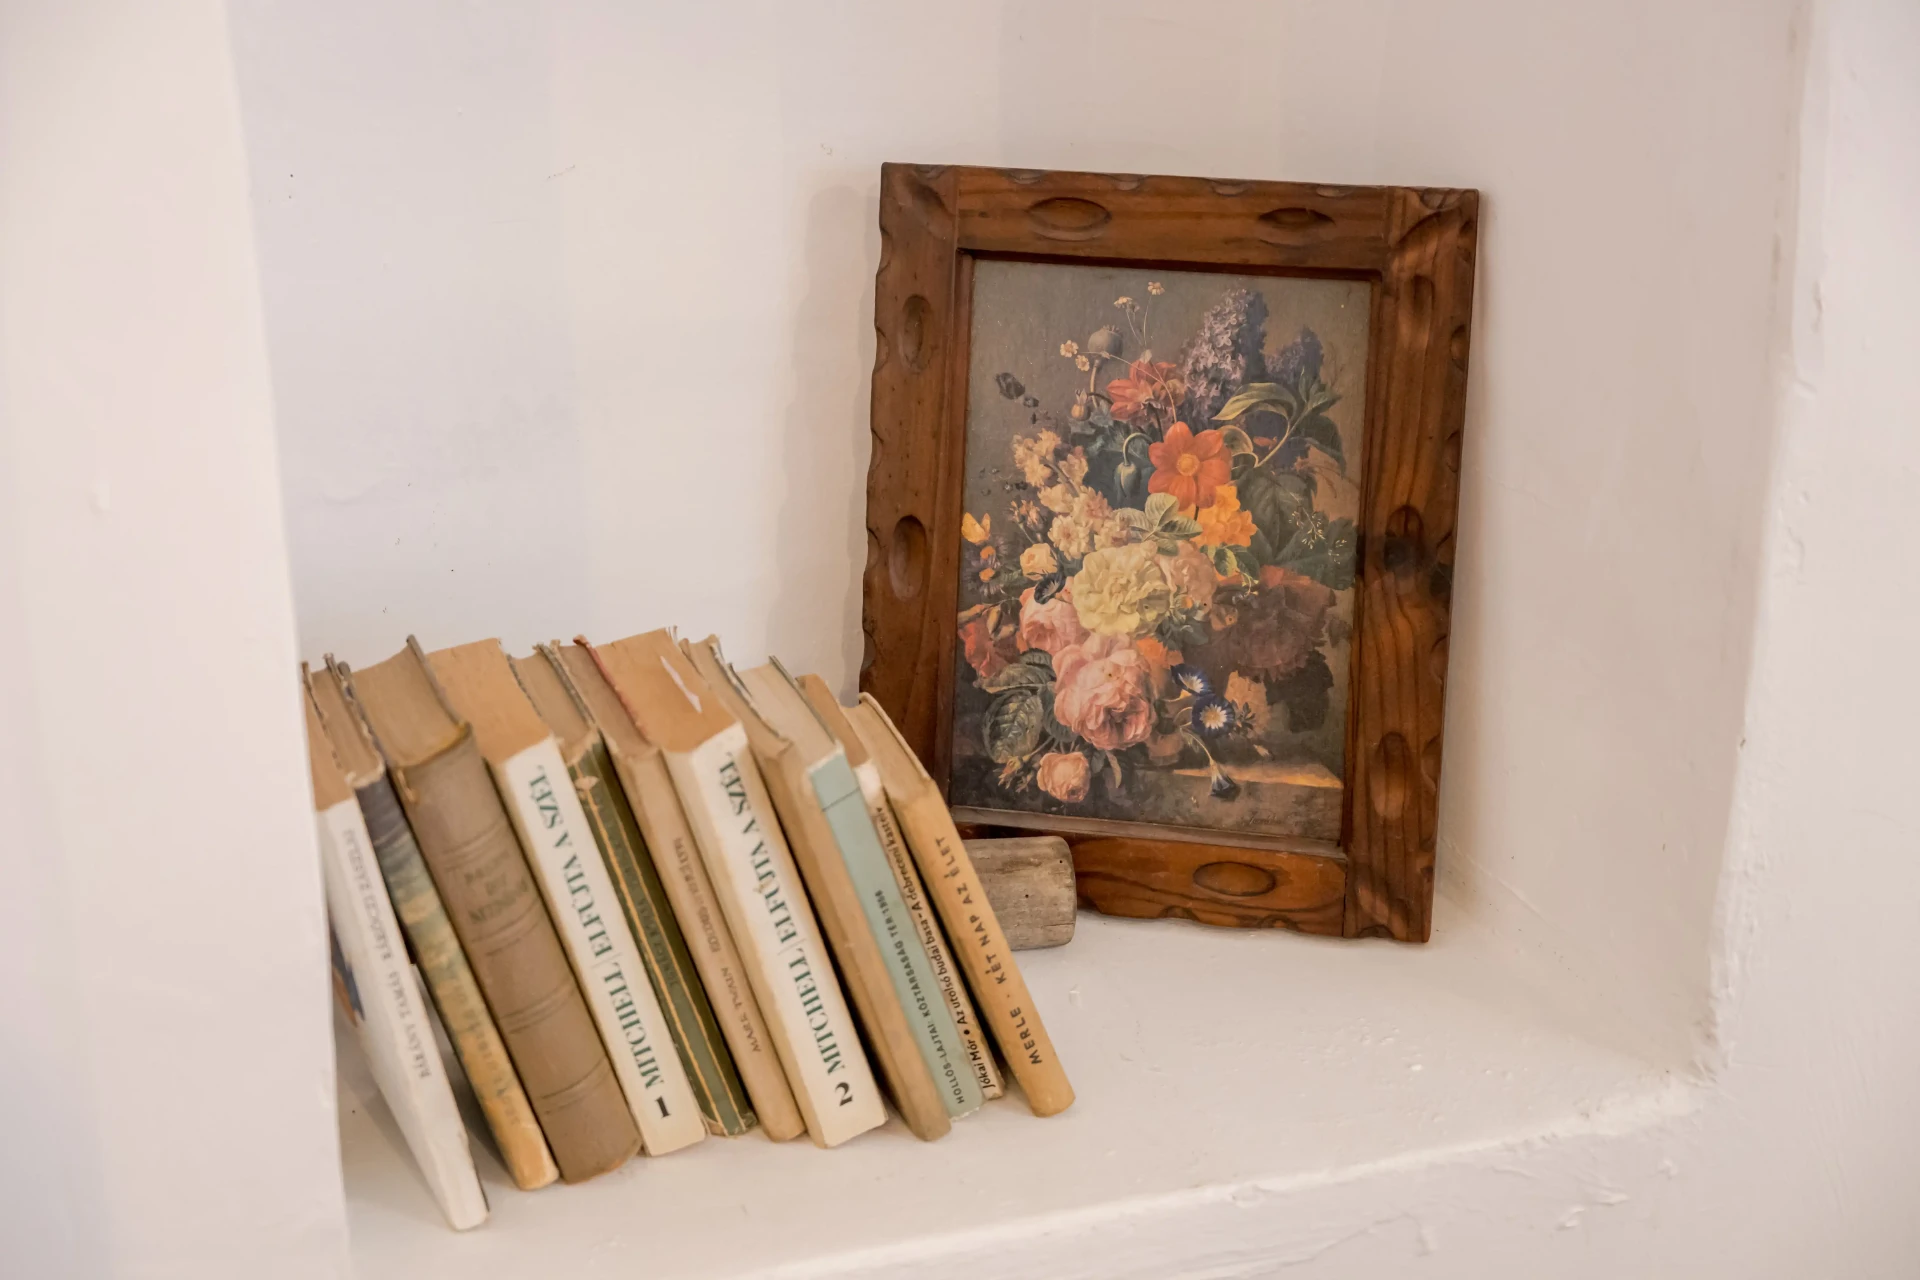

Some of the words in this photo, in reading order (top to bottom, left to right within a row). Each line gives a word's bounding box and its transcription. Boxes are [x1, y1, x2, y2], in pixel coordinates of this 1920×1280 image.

[528, 763, 566, 829] SZÉL
[719, 752, 754, 815] SZÉL
[550, 828, 573, 851] A
[738, 816, 760, 837] A
[885, 844, 921, 902] debreceni
[933, 834, 962, 880] ÉLET
[560, 854, 616, 957] ELFÚJTA
[747, 840, 800, 944] ELFÚJTA
[954, 881, 974, 907] AZ
[967, 911, 991, 947] NAP
[925, 942, 949, 976] budai
[984, 951, 1008, 985] KÉT
[786, 946, 847, 1073] MITCHELL
[938, 974, 963, 1010] utolsó
[603, 961, 666, 1088] MITCHELL
[952, 1008, 969, 1027] Az
[1007, 1005, 1044, 1066] MERLE
[963, 1036, 983, 1062] Mór
[831, 1079, 855, 1107] 2
[972, 1060, 995, 1091] Jókai
[653, 1094, 671, 1119] 1
